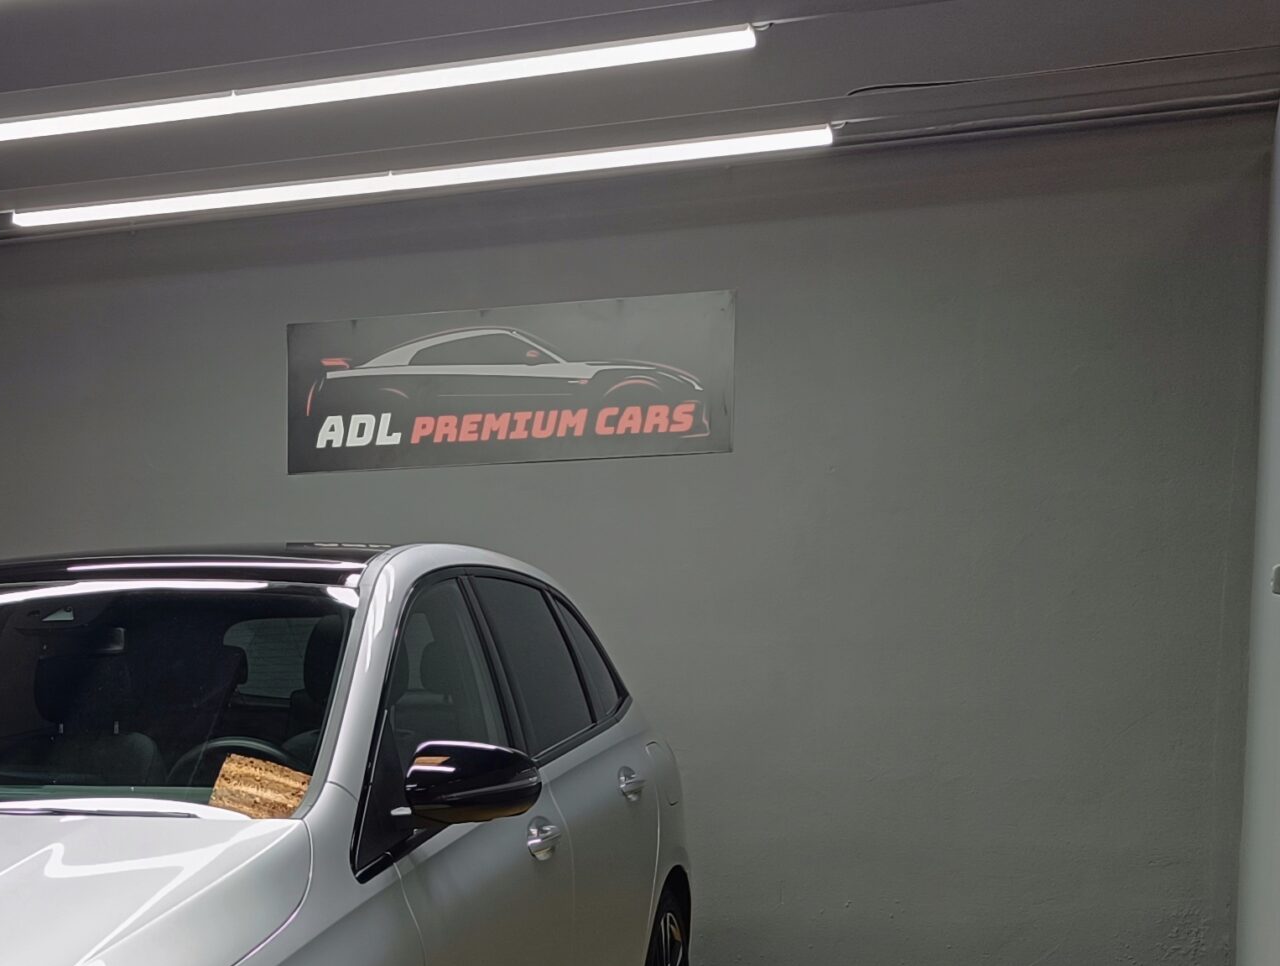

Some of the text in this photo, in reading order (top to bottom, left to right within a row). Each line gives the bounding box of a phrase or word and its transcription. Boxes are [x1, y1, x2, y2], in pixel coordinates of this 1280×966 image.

[316, 403, 696, 449] ADL PREMIUM CARS
